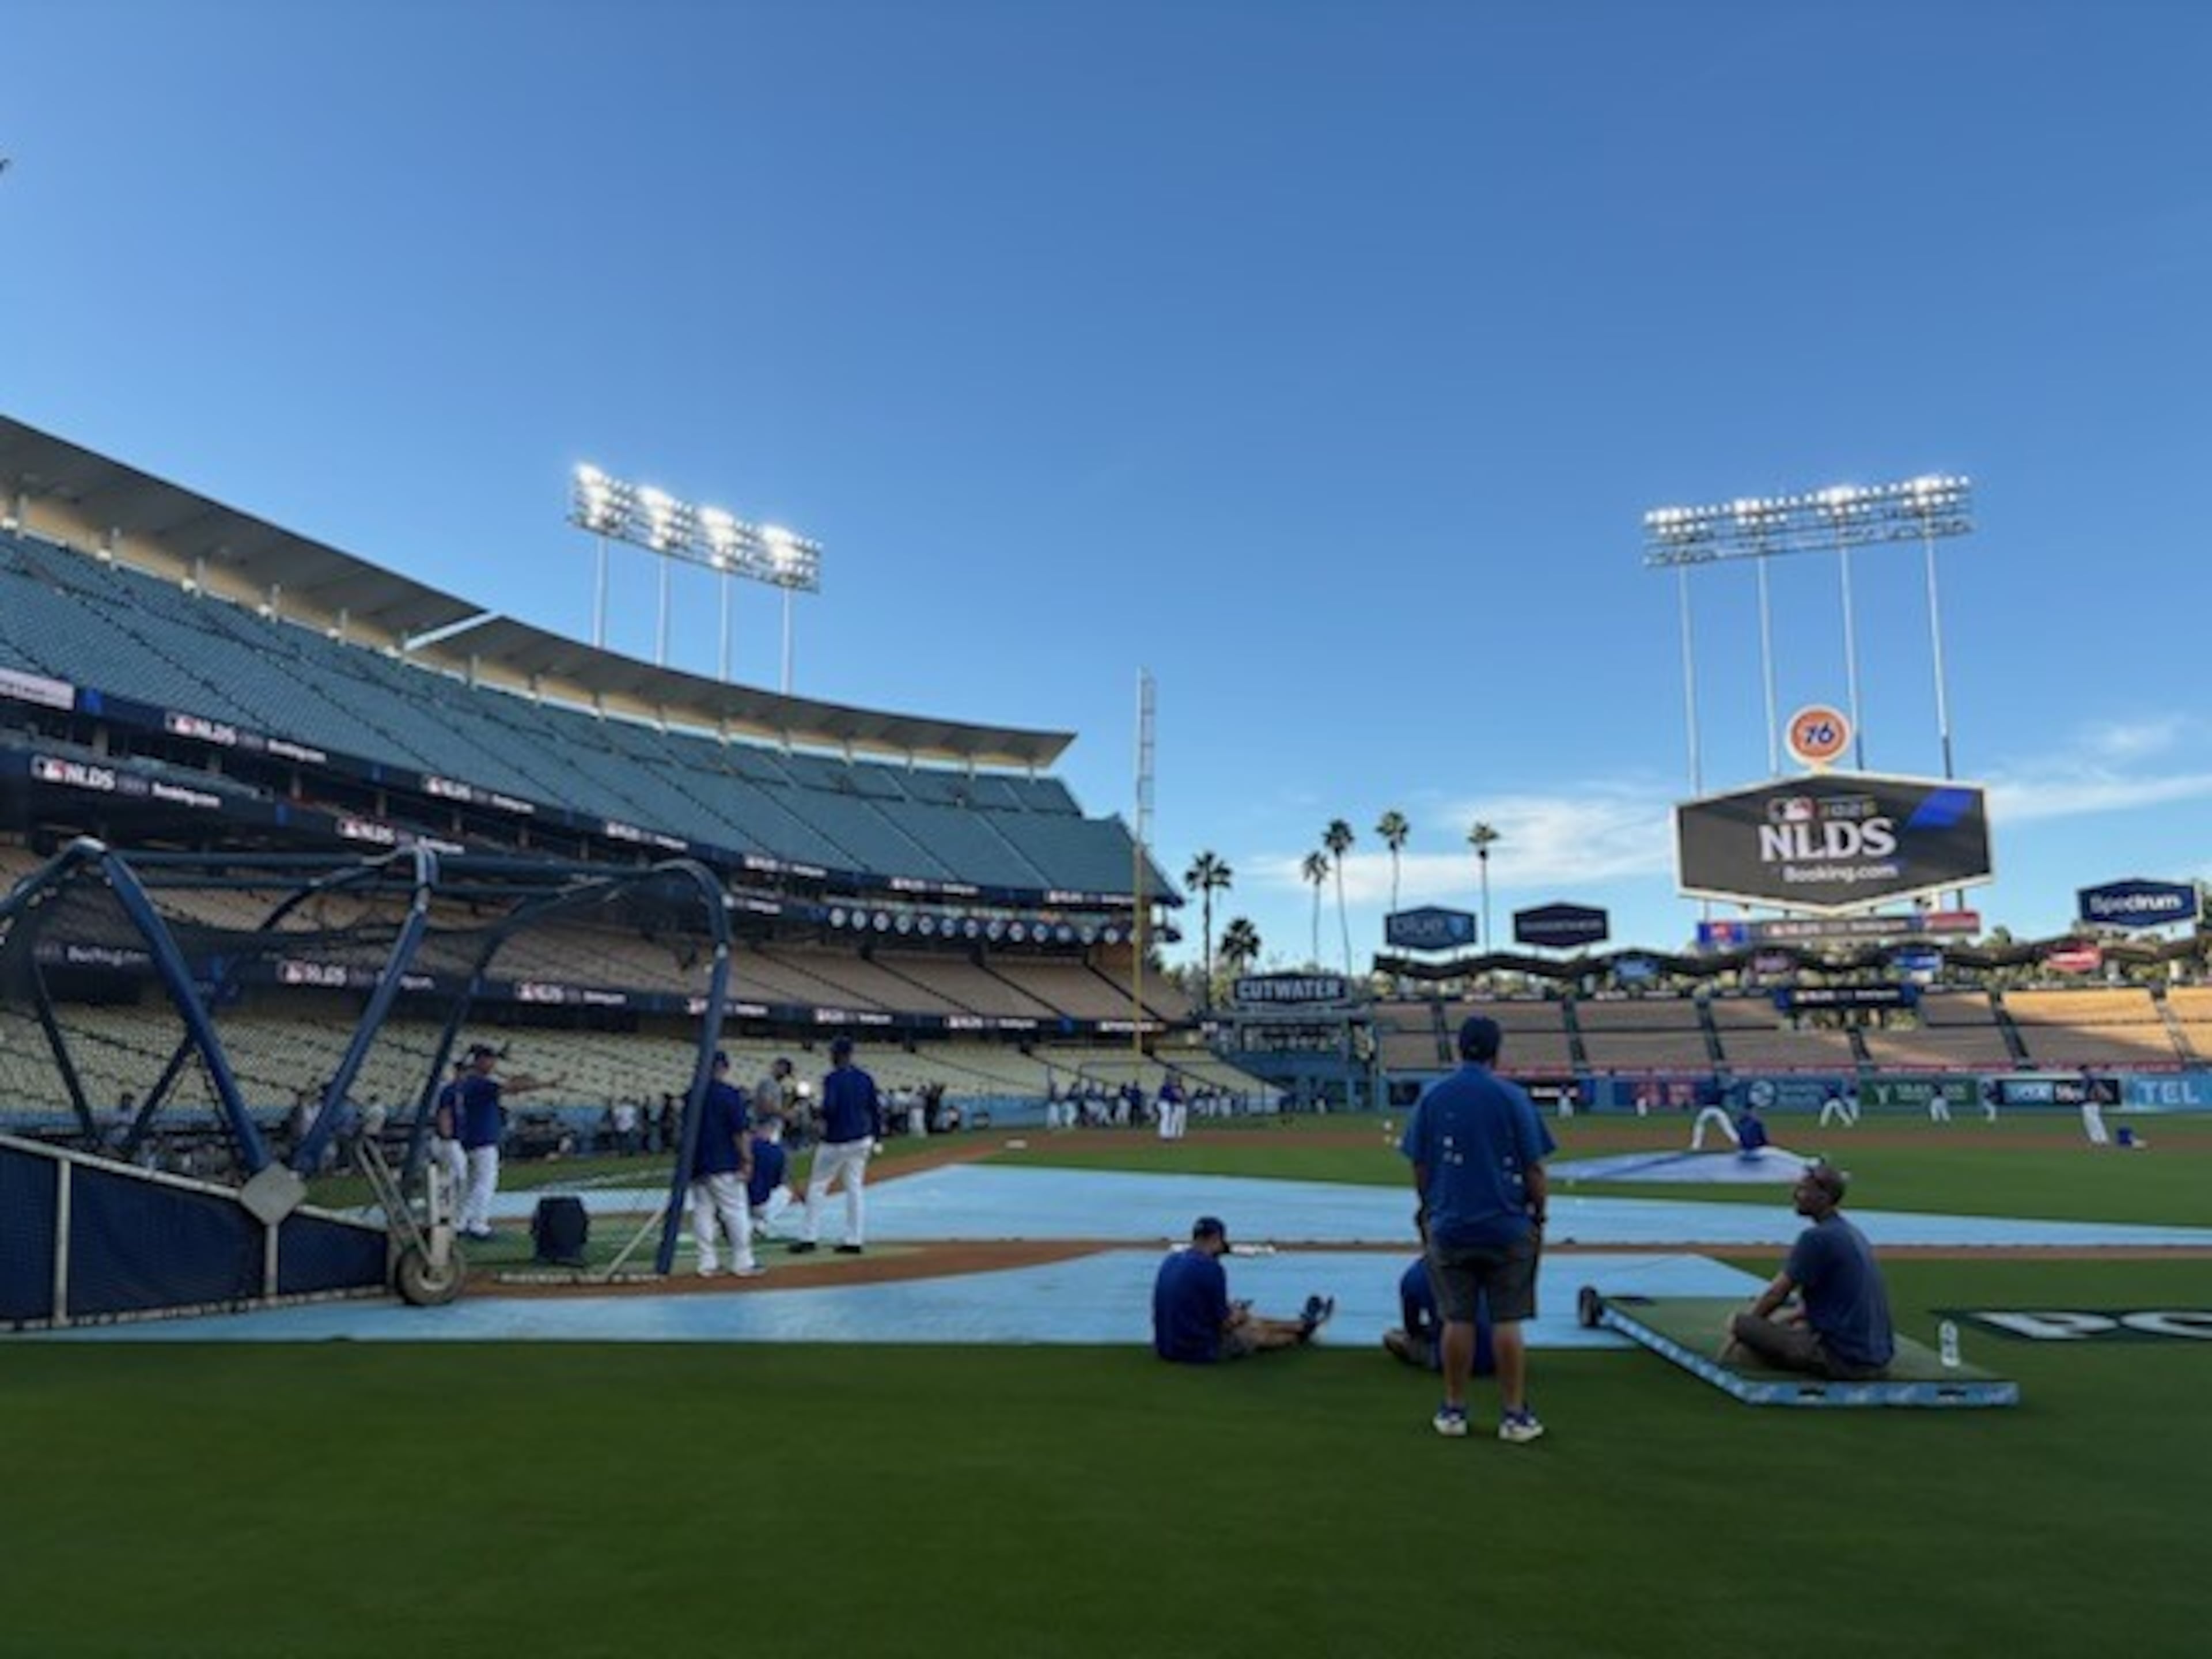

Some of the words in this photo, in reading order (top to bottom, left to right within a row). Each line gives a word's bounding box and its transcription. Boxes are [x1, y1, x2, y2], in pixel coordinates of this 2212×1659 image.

[1805, 720, 1835, 745] 76
[65, 763, 115, 791] NLDS
[1758, 817, 1897, 862] NLDS
[1783, 864, 1899, 883] Booking.com
[2089, 893, 2183, 916] Spectrum
[1238, 979, 1339, 1001] CUTWATER
